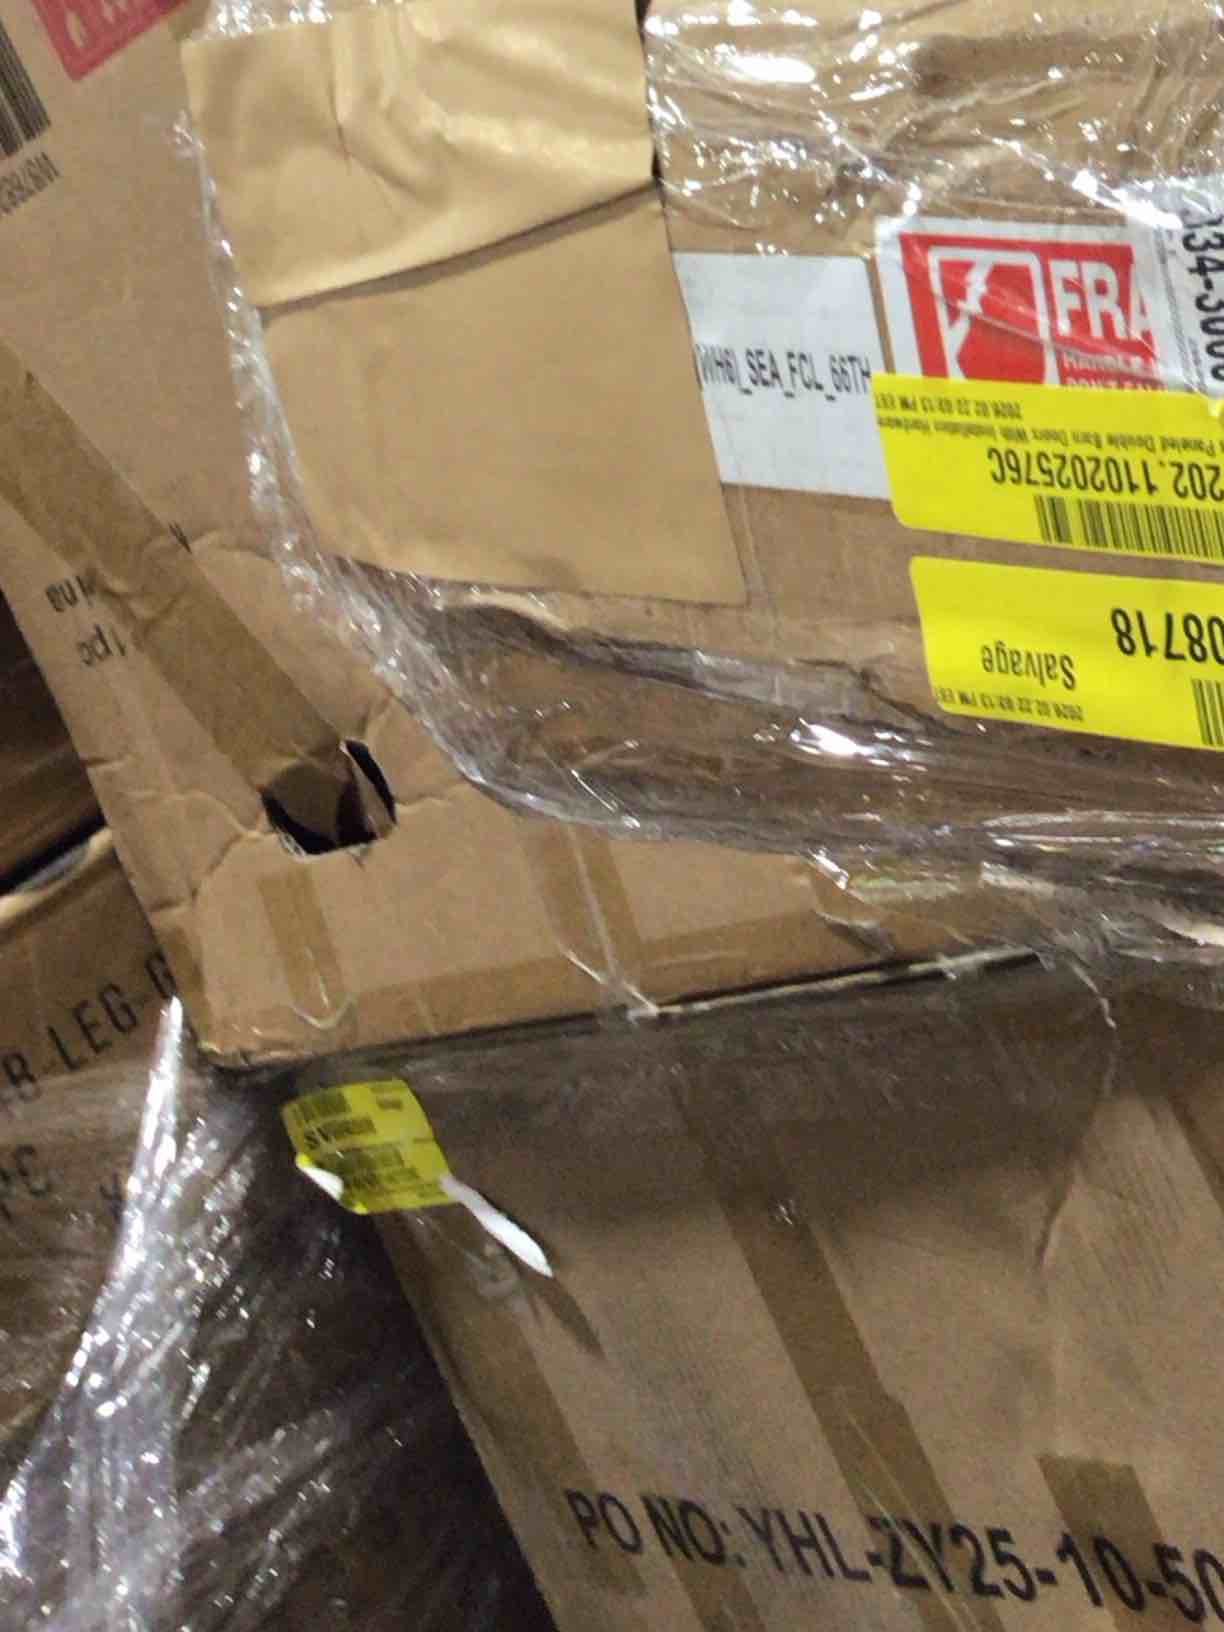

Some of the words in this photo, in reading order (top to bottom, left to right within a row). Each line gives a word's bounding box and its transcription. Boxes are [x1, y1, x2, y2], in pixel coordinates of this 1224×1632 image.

[980, 640, 1077, 691] Salvage
[47, 982, 138, 1071] LEG
[564, 1488, 642, 1557] PO
[641, 1494, 745, 1569] NO:
